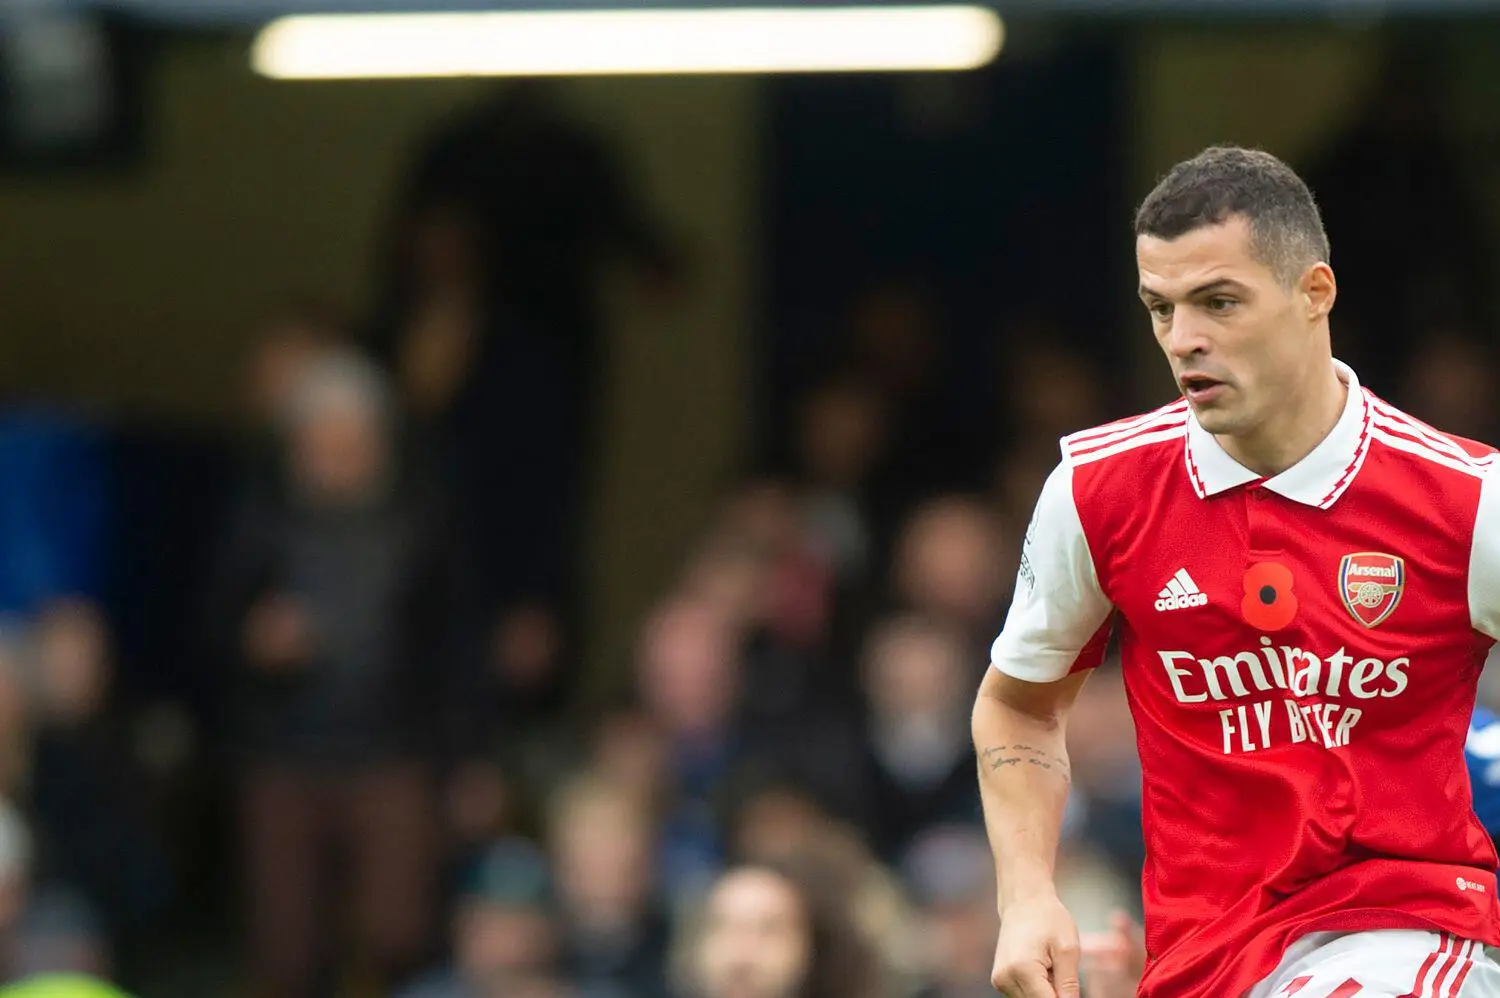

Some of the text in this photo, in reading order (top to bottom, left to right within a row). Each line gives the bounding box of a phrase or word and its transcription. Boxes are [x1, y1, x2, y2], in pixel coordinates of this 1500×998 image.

[1348, 563, 1396, 578] Arsenal
[1154, 592, 1208, 611] adidas
[1158, 635, 1410, 703] Emirates
[1219, 701, 1272, 754] FLY
[1284, 699, 1362, 749] BTTER
